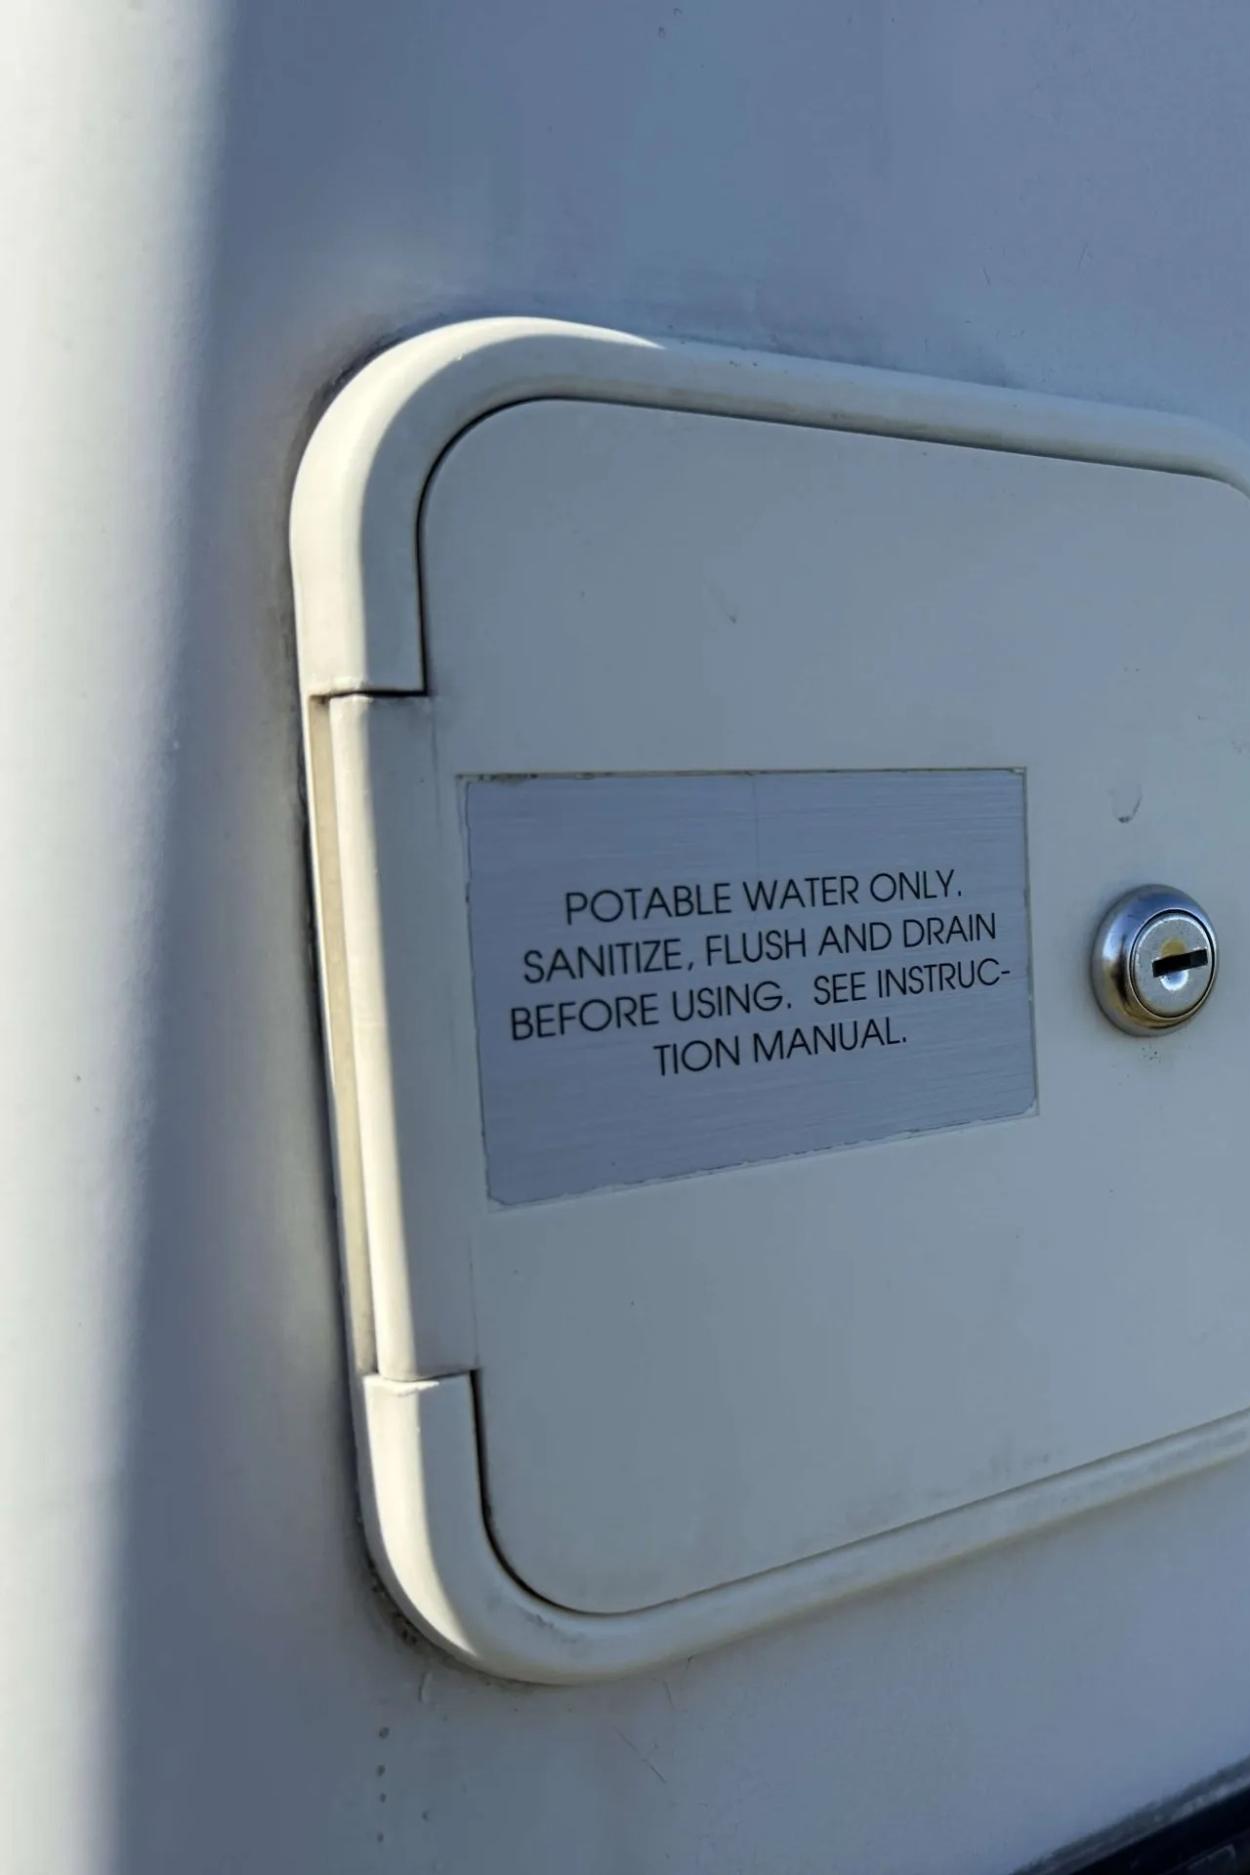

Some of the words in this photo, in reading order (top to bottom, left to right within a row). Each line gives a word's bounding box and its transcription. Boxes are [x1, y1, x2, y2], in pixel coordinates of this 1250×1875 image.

[565, 881, 732, 926] POTABLE
[742, 875, 858, 911] WATER
[869, 868, 963, 902] ONLY.
[522, 938, 695, 984] SANITIZE,
[705, 927, 807, 967] FLUSH
[817, 921, 891, 956] AND
[902, 912, 997, 948] DRAIN
[511, 992, 658, 1041] BEFORE
[671, 980, 793, 1022] USING.
[813, 971, 866, 1006] SEE
[876, 957, 1012, 997] INSTRUC-
[653, 1035, 740, 1076] TION
[753, 1017, 908, 1063] MANUAL.
